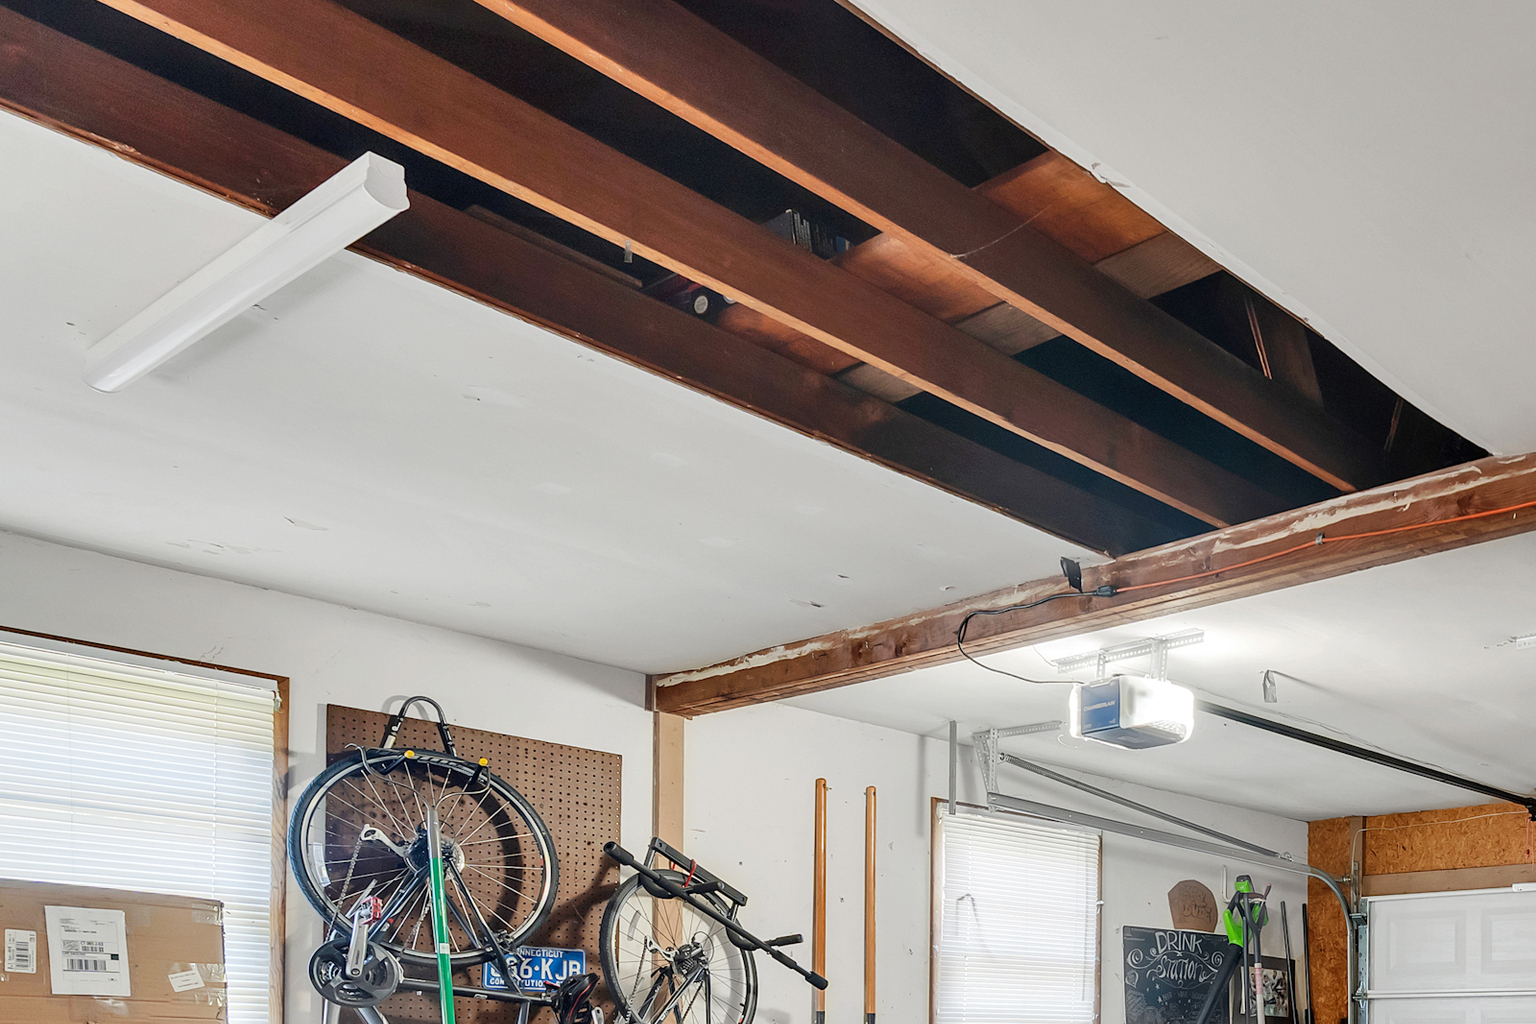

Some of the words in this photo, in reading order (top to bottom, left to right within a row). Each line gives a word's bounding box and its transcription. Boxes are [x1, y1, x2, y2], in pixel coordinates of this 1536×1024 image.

[1083, 700, 1116, 712] CHAMBERLAIN
[1154, 931, 1203, 954] DRINK
[518, 948, 564, 959] NNECTICUT
